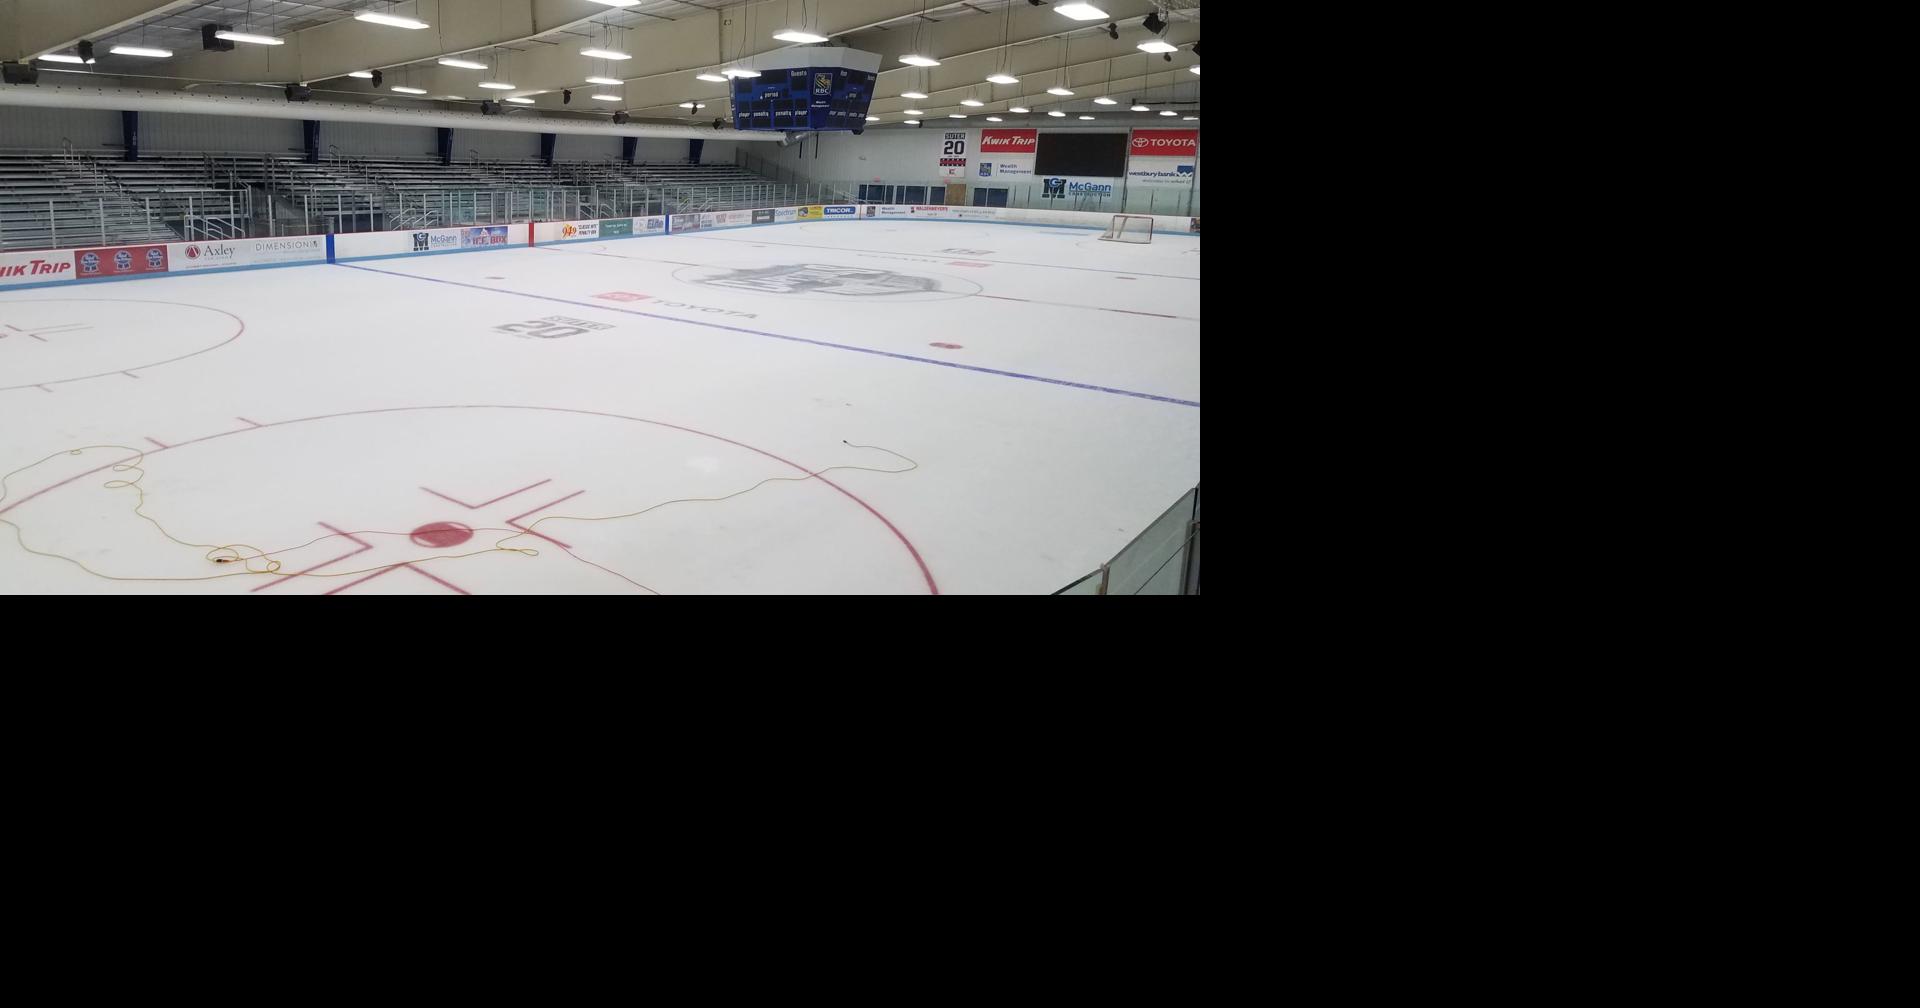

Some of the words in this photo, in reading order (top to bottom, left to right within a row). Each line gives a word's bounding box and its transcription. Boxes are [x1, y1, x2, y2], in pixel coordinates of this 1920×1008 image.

[982, 135, 1009, 145] KWIK
[1011, 135, 1036, 145] TRIP
[1150, 138, 1196, 147] TOYOTA
[943, 140, 965, 155] 20
[1069, 182, 1112, 191] McGann
[204, 244, 235, 258] Axley
[30, 260, 70, 275] TRIP
[653, 300, 759, 320] TOYOTA
